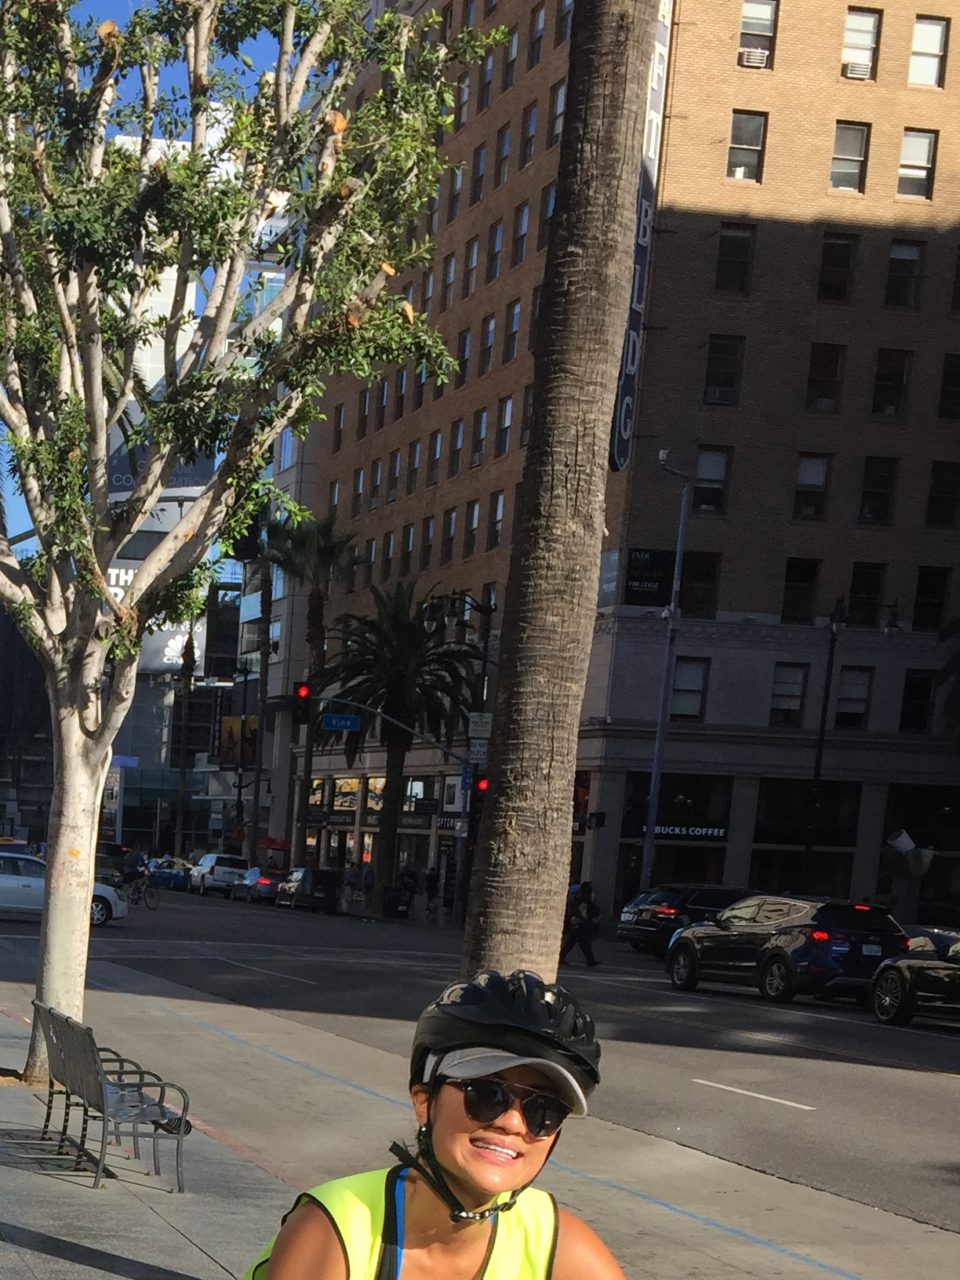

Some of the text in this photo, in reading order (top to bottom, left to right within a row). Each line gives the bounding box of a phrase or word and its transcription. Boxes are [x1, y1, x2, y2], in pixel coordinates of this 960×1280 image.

[619, 199, 653, 440] BLDG
[107, 568, 139, 586] TH
[331, 718, 352, 727] Vine
[642, 825, 726, 837] BUCKS COFFEE
